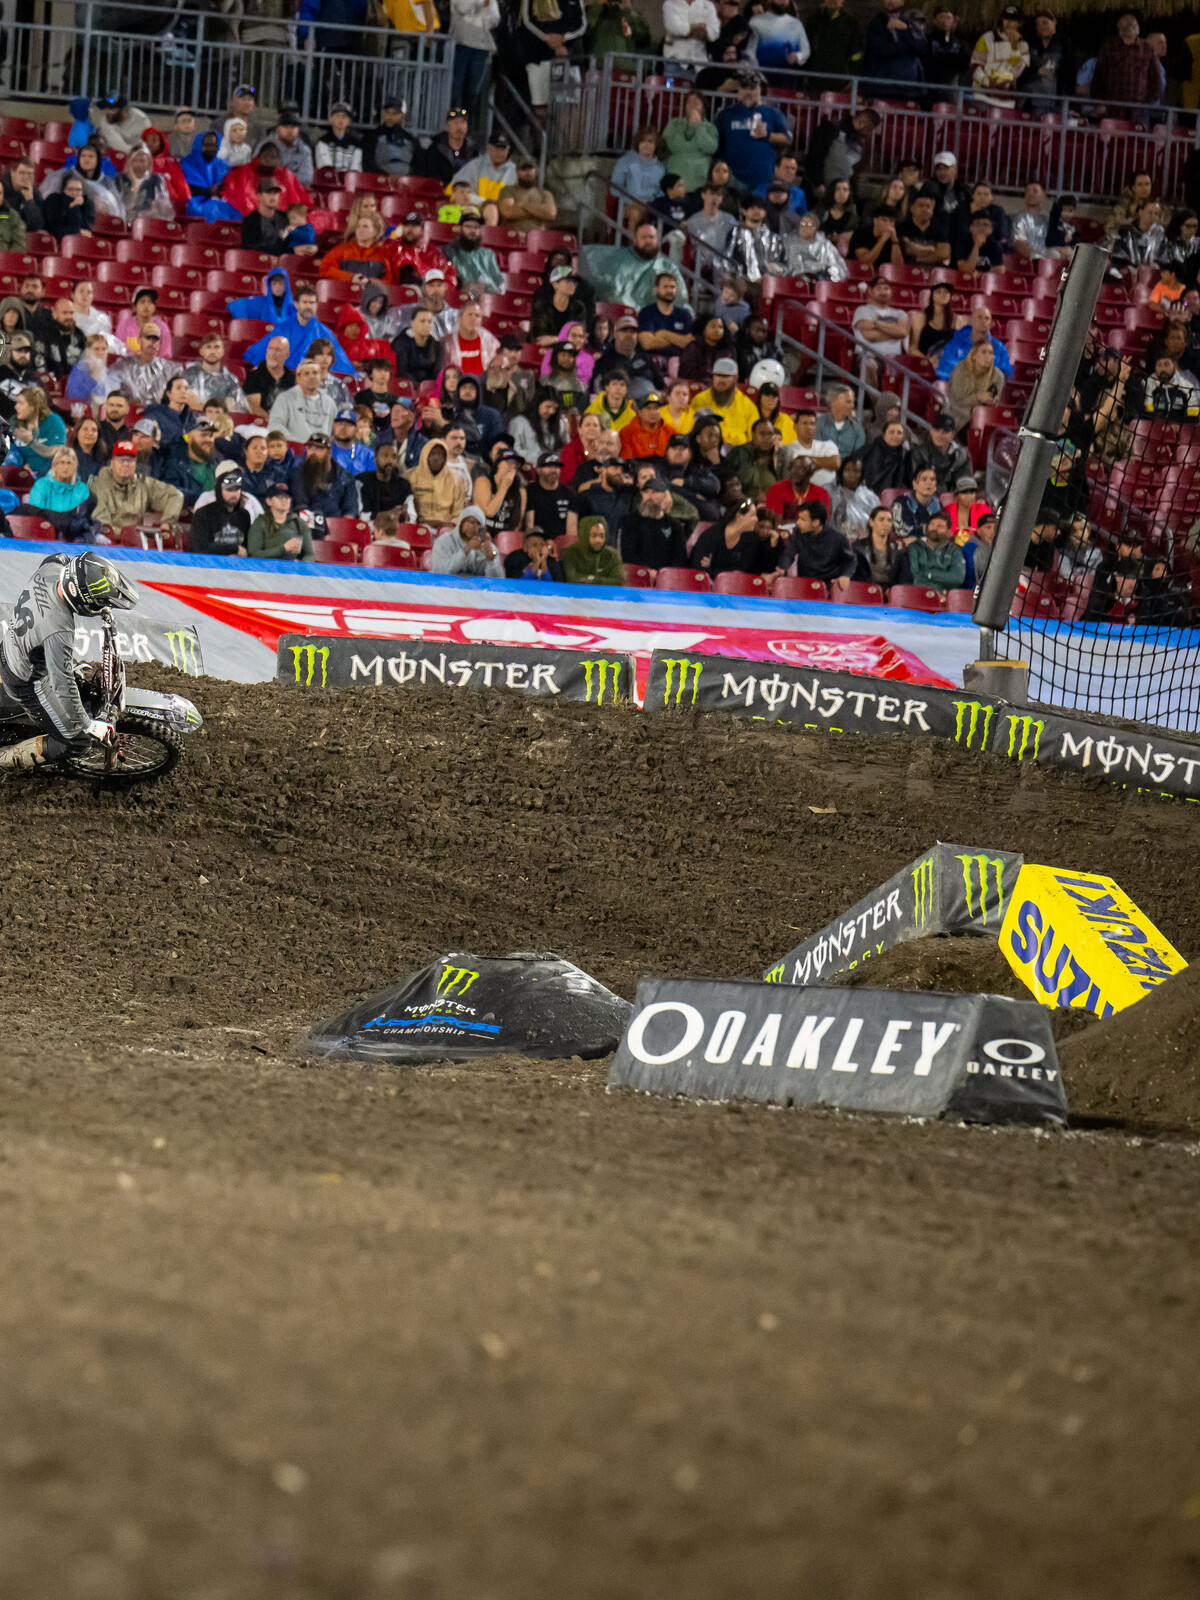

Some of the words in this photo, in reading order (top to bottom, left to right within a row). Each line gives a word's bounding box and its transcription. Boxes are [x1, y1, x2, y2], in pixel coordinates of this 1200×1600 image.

[1053, 875, 1174, 990] UZUKI
[383, 1025, 466, 1036] CHAMPIONSHIP
[703, 1010, 958, 1077] OAKLEY
[966, 1061, 1058, 1083] OAKLEY
